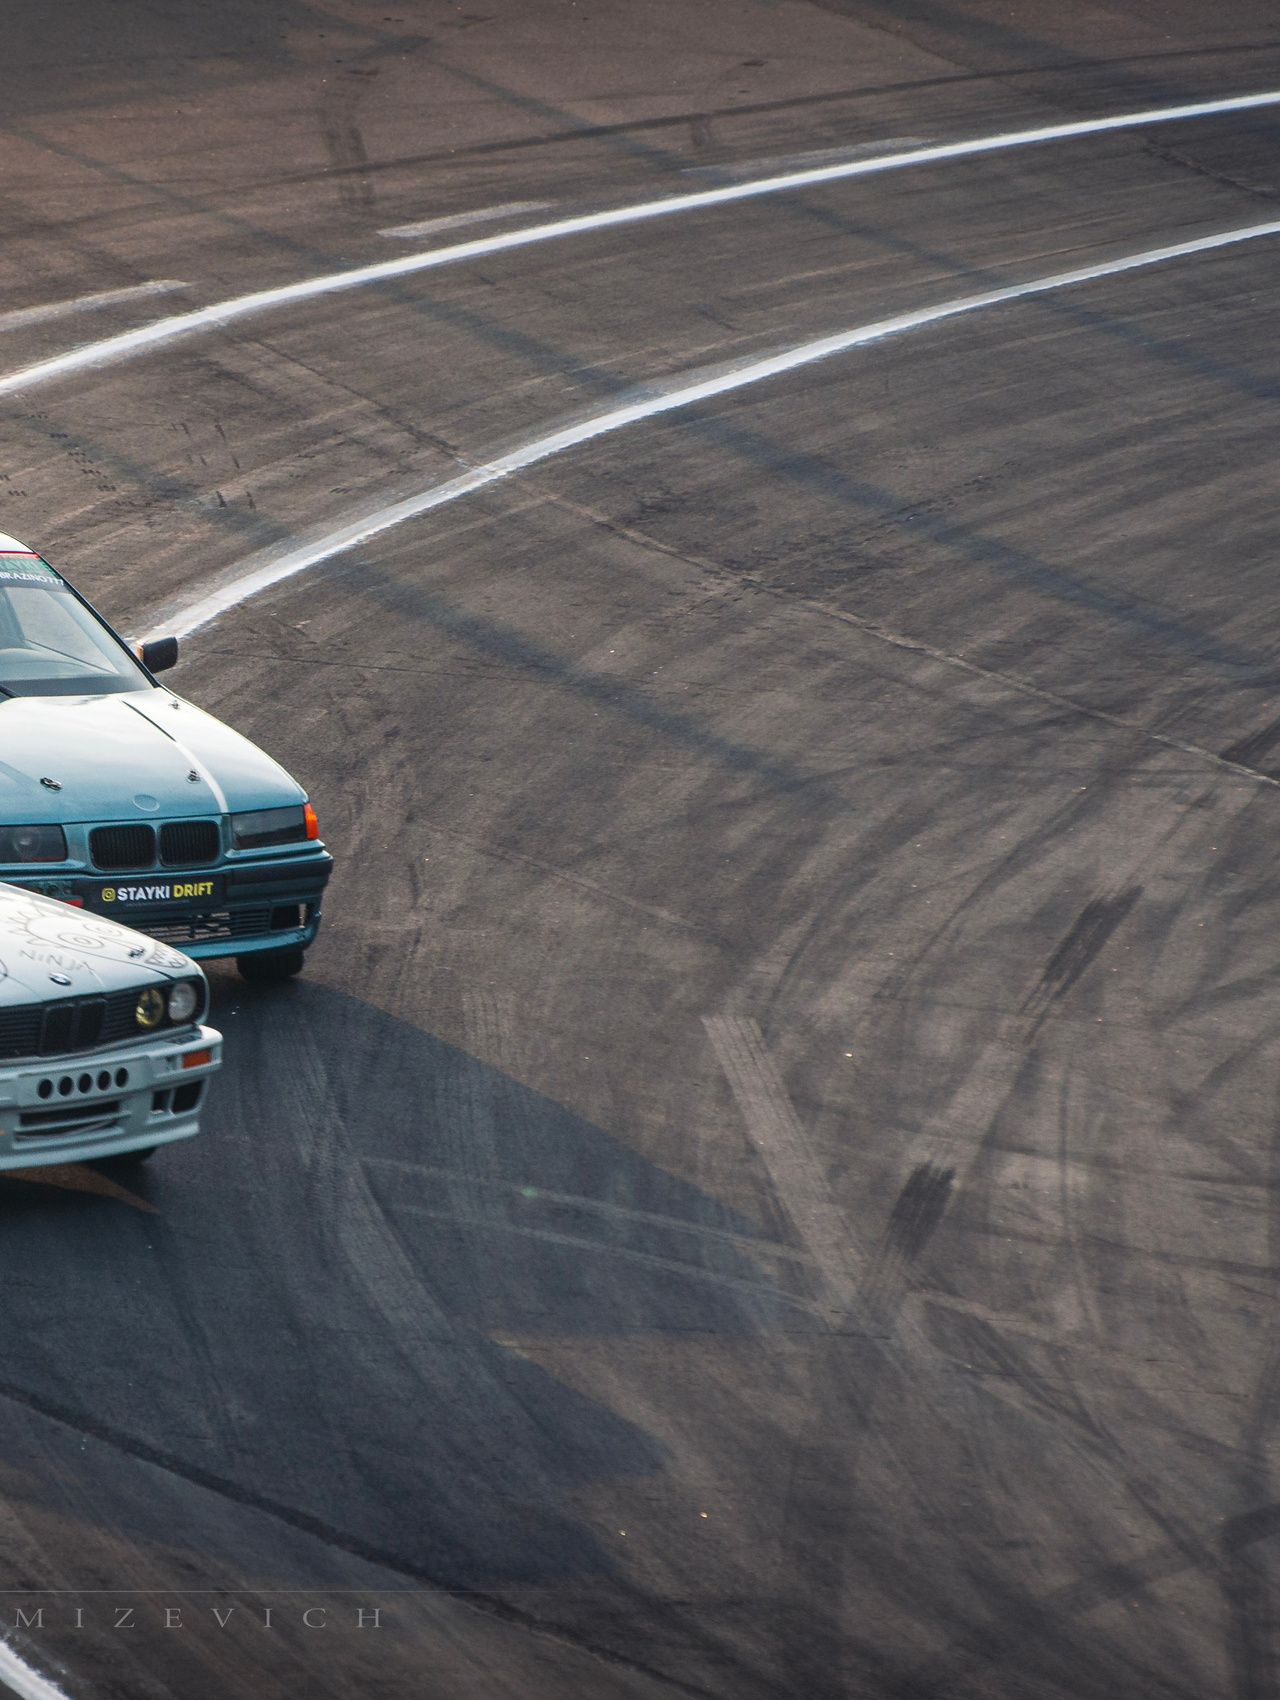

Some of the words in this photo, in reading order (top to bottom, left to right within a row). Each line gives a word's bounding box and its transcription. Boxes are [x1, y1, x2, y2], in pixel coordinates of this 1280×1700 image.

[117, 885, 171, 901] STAYKI
[173, 881, 214, 898] DRIFT
[18, 949, 96, 976] NINJA
